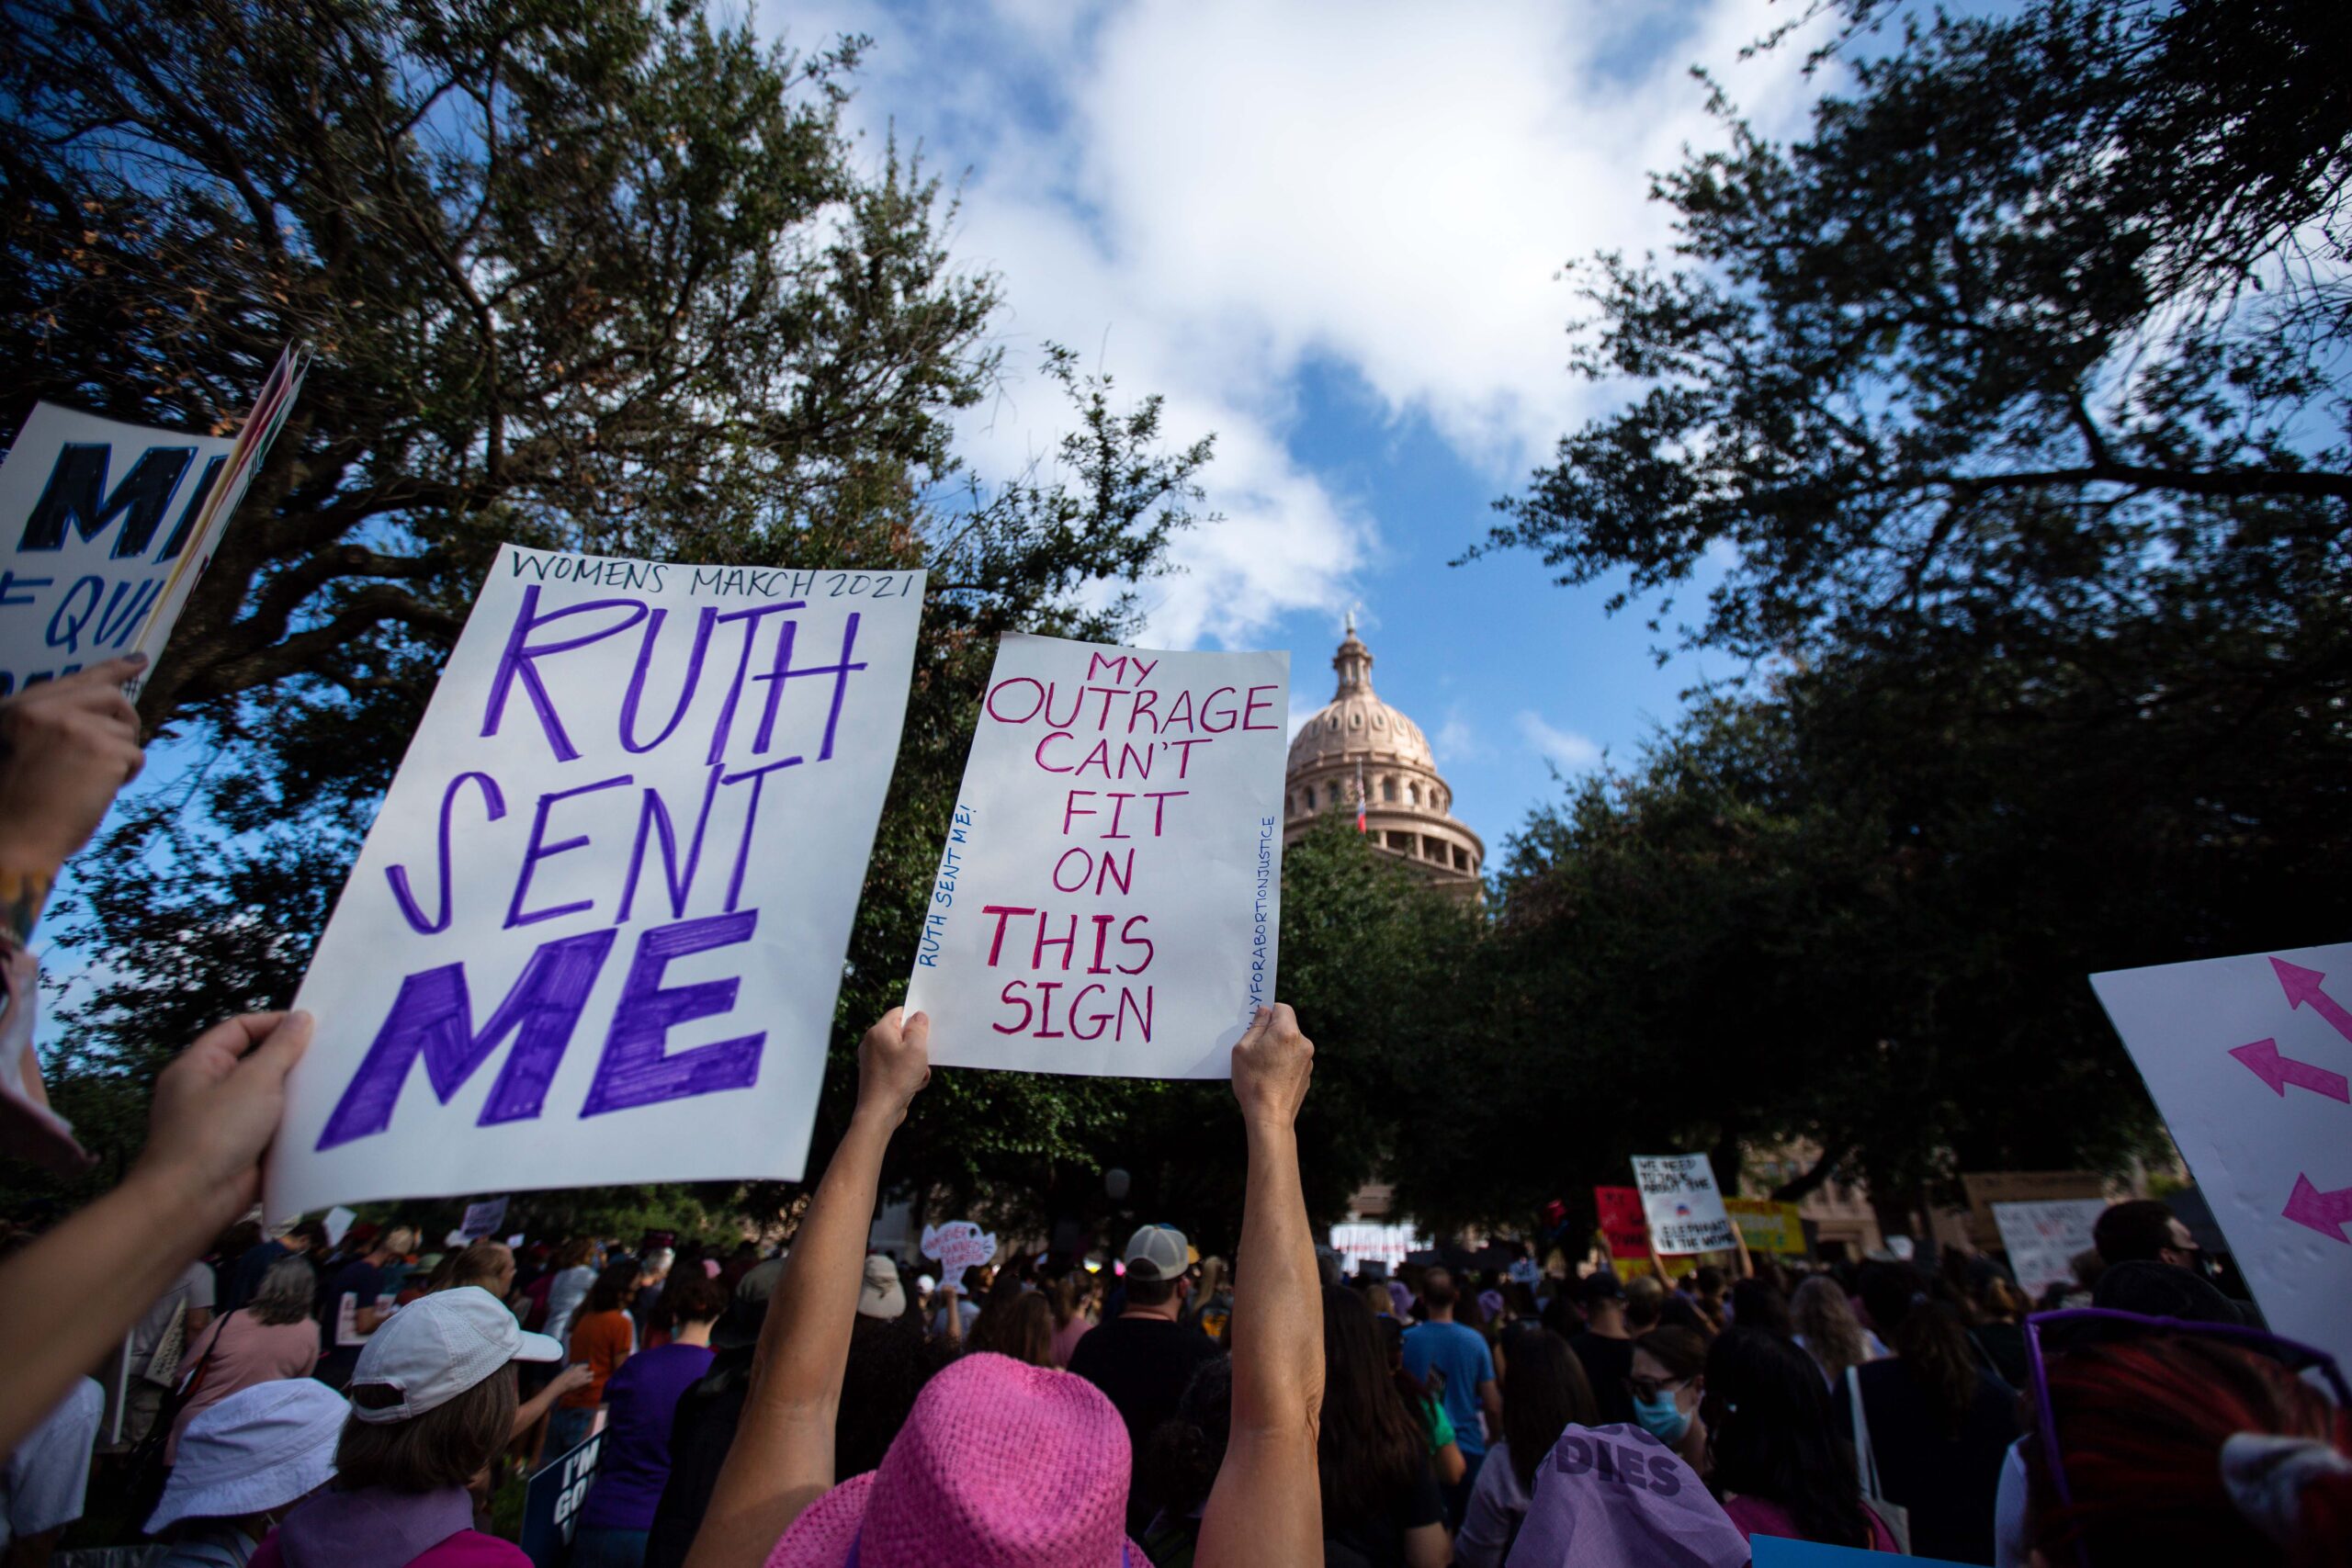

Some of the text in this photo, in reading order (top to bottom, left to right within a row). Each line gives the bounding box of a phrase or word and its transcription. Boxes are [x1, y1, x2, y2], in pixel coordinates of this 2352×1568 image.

[512, 551, 914, 599] WOMENS MARCH 2021
[479, 584, 868, 766] RUTH
[1086, 651, 1159, 687] MY
[986, 677, 1280, 734] OUTRAGE
[1035, 732, 1214, 780] CAN'T
[385, 755, 805, 936] SENT
[1063, 790, 1190, 840] FIT
[919, 803, 978, 968] RUTH SENT ME!
[1053, 847, 1136, 897] ON
[982, 905, 1155, 976] THIS
[1247, 816, 1275, 1030] YFORABORTIONJUSTICE
[314, 908, 768, 1152] ME
[992, 980, 1154, 1044] SIGN
